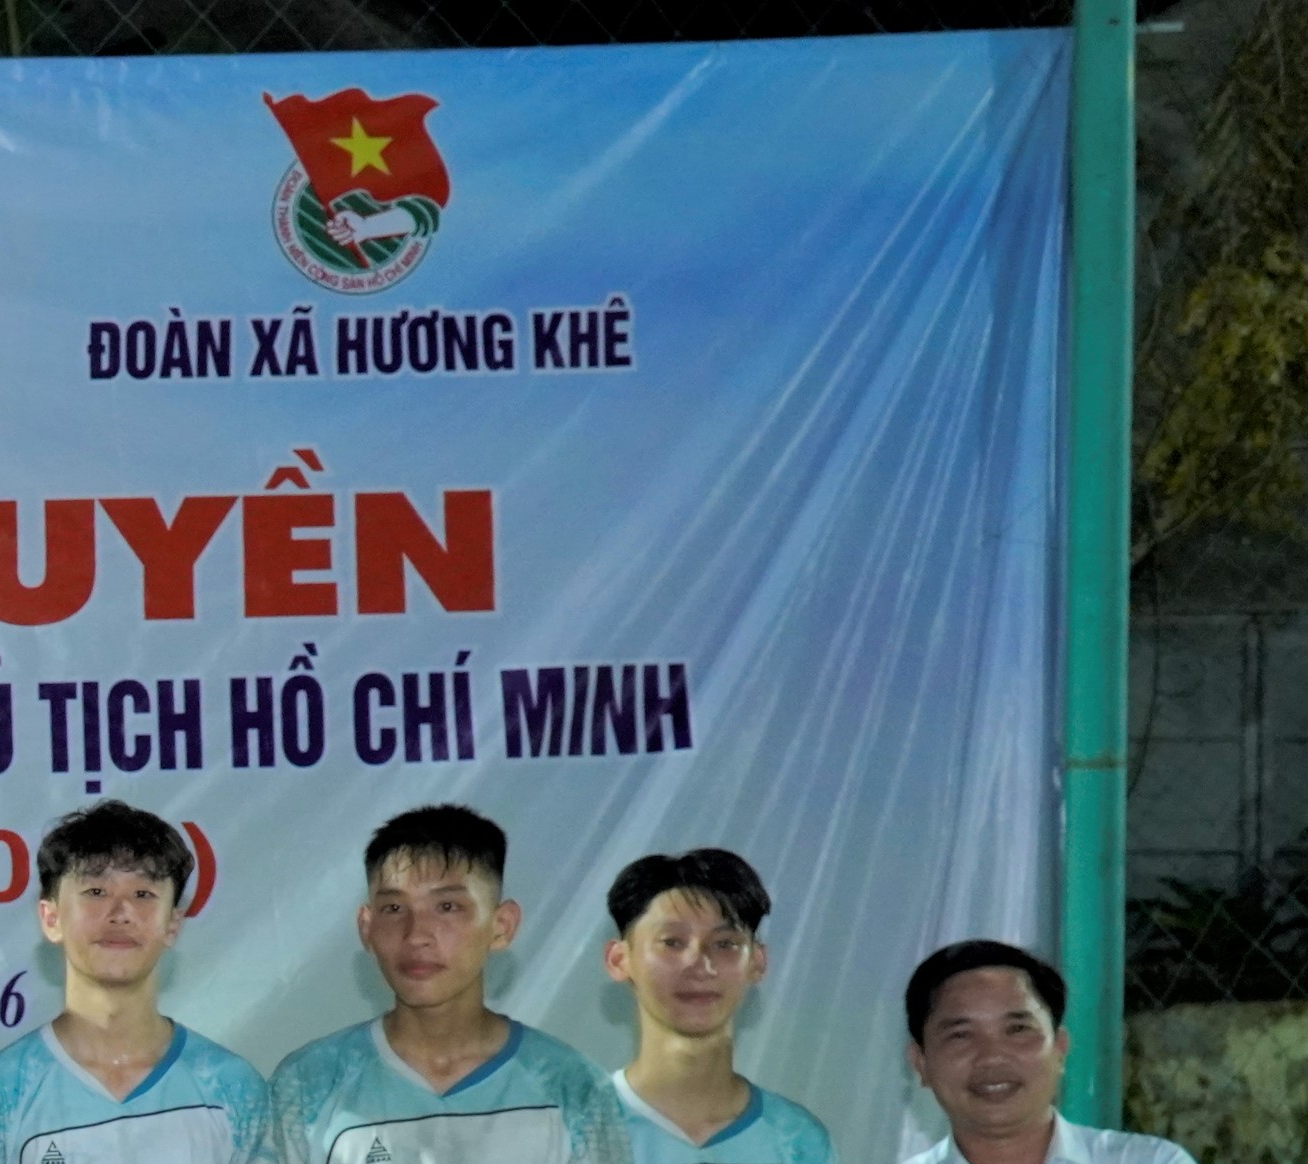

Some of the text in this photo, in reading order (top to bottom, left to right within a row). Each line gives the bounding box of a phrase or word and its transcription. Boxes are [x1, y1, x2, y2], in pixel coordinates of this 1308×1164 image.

[88, 297, 632, 380] ĐOÀN XÃ HƯƠNG KHÊ
[39, 677, 203, 794] TỊCH
[230, 644, 325, 769] HỒ
[352, 650, 475, 766] CHÍ
[501, 662, 694, 760] MINH
